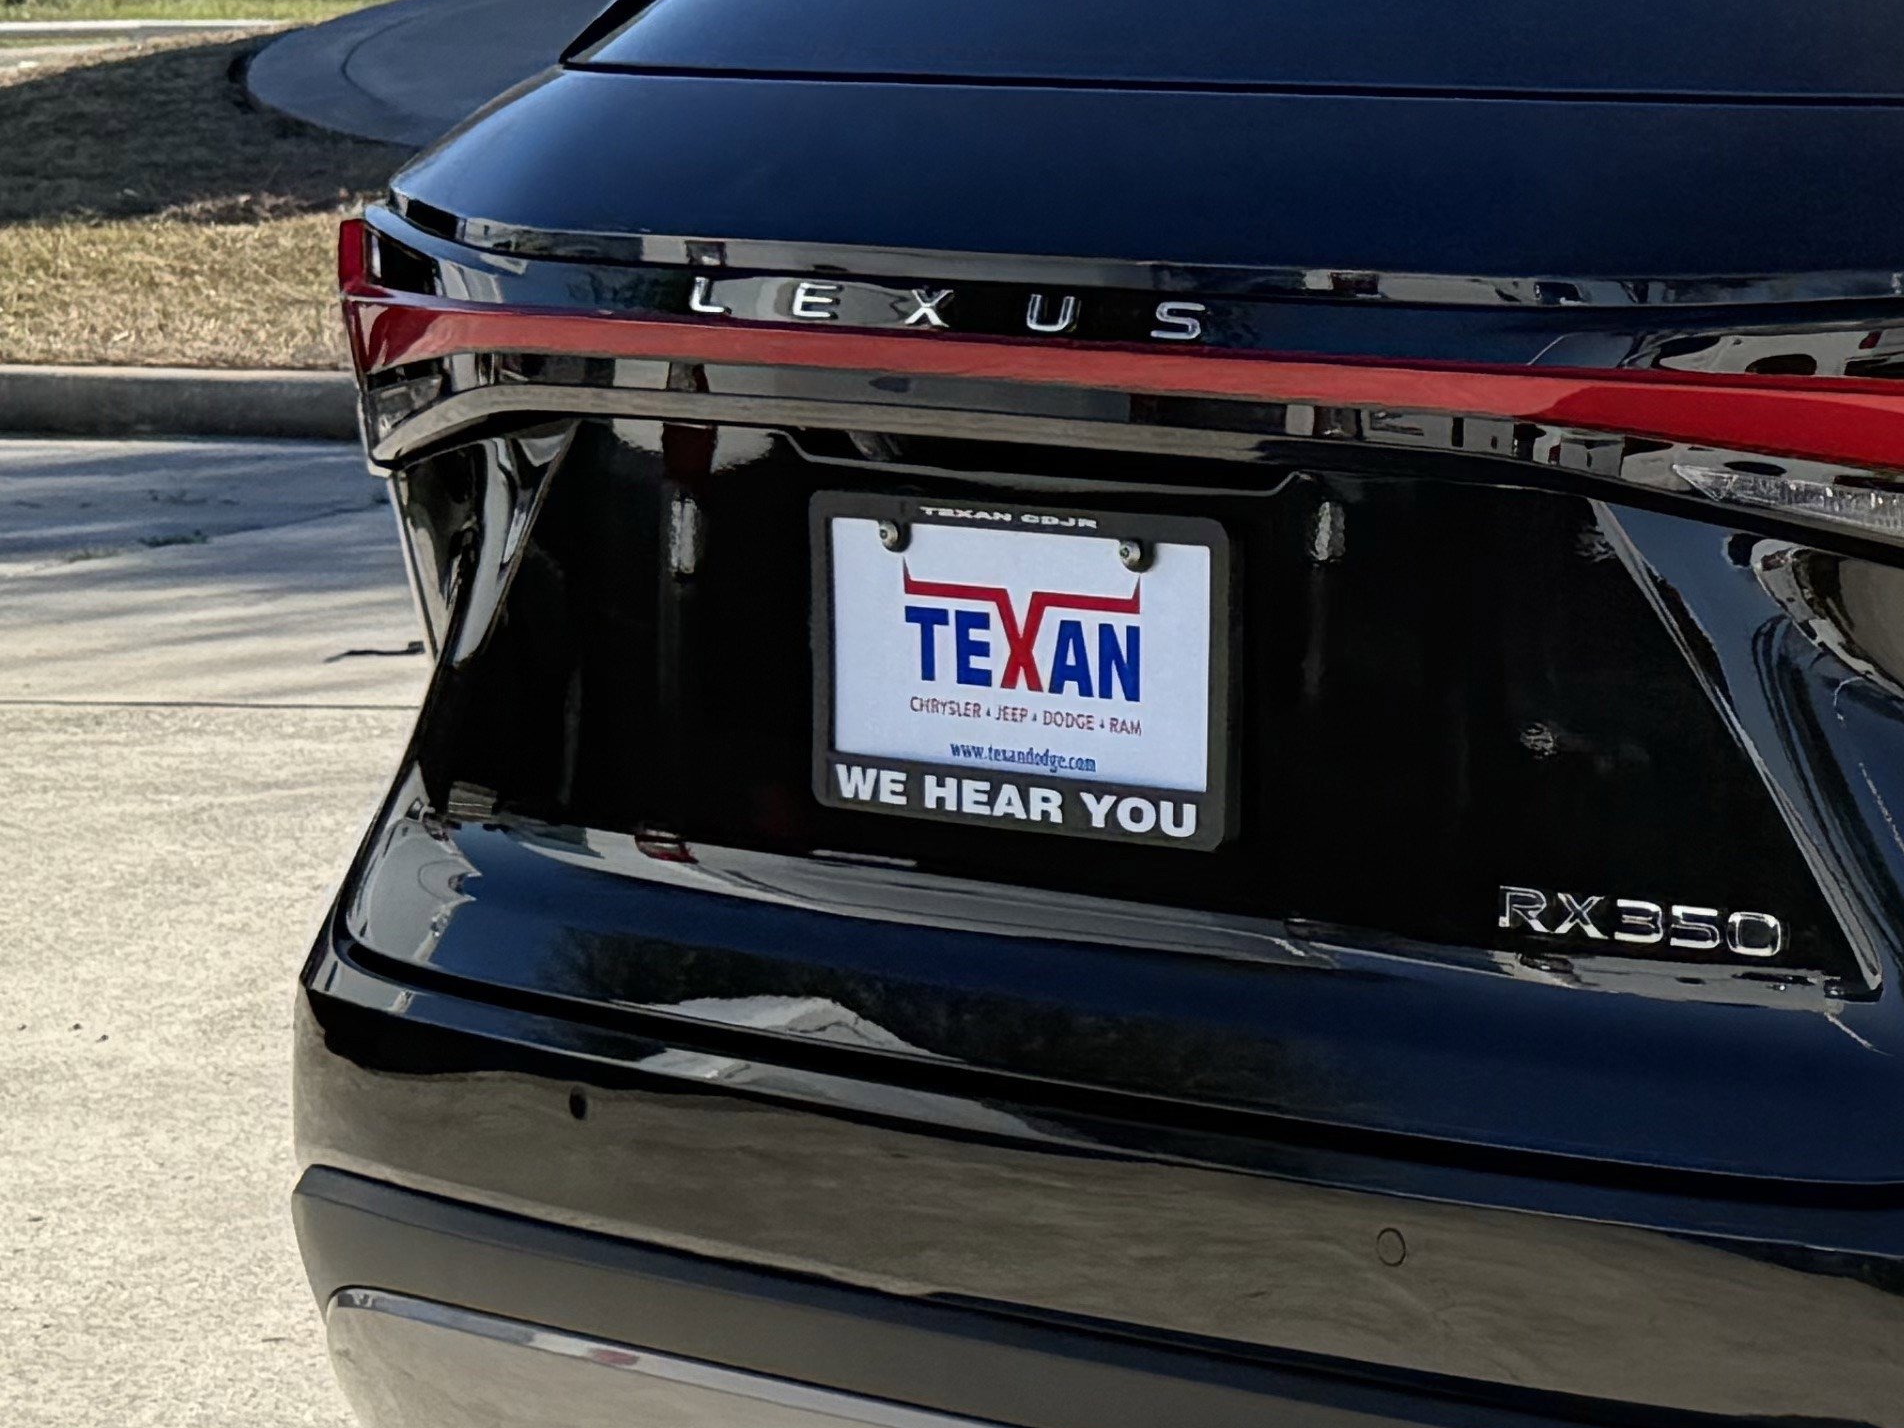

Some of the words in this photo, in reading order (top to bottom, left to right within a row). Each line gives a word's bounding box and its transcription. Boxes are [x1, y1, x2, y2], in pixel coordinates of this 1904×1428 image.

[689, 275, 1207, 341] LEXUS
[919, 506, 1012, 522] TEXAN
[1021, 514, 1097, 529] CDJR
[903, 556, 1141, 703] TEXAN
[909, 696, 982, 719] CHRYSLER
[996, 704, 1028, 723] JEEP
[1043, 710, 1095, 731] DODGE
[1109, 717, 1142, 737] RAM
[950, 742, 1097, 773] www.texandodge.com
[836, 762, 907, 805] WE
[924, 774, 1063, 824] HEAR
[1080, 791, 1197, 838] YOU
[1498, 885, 1783, 958] RX350
